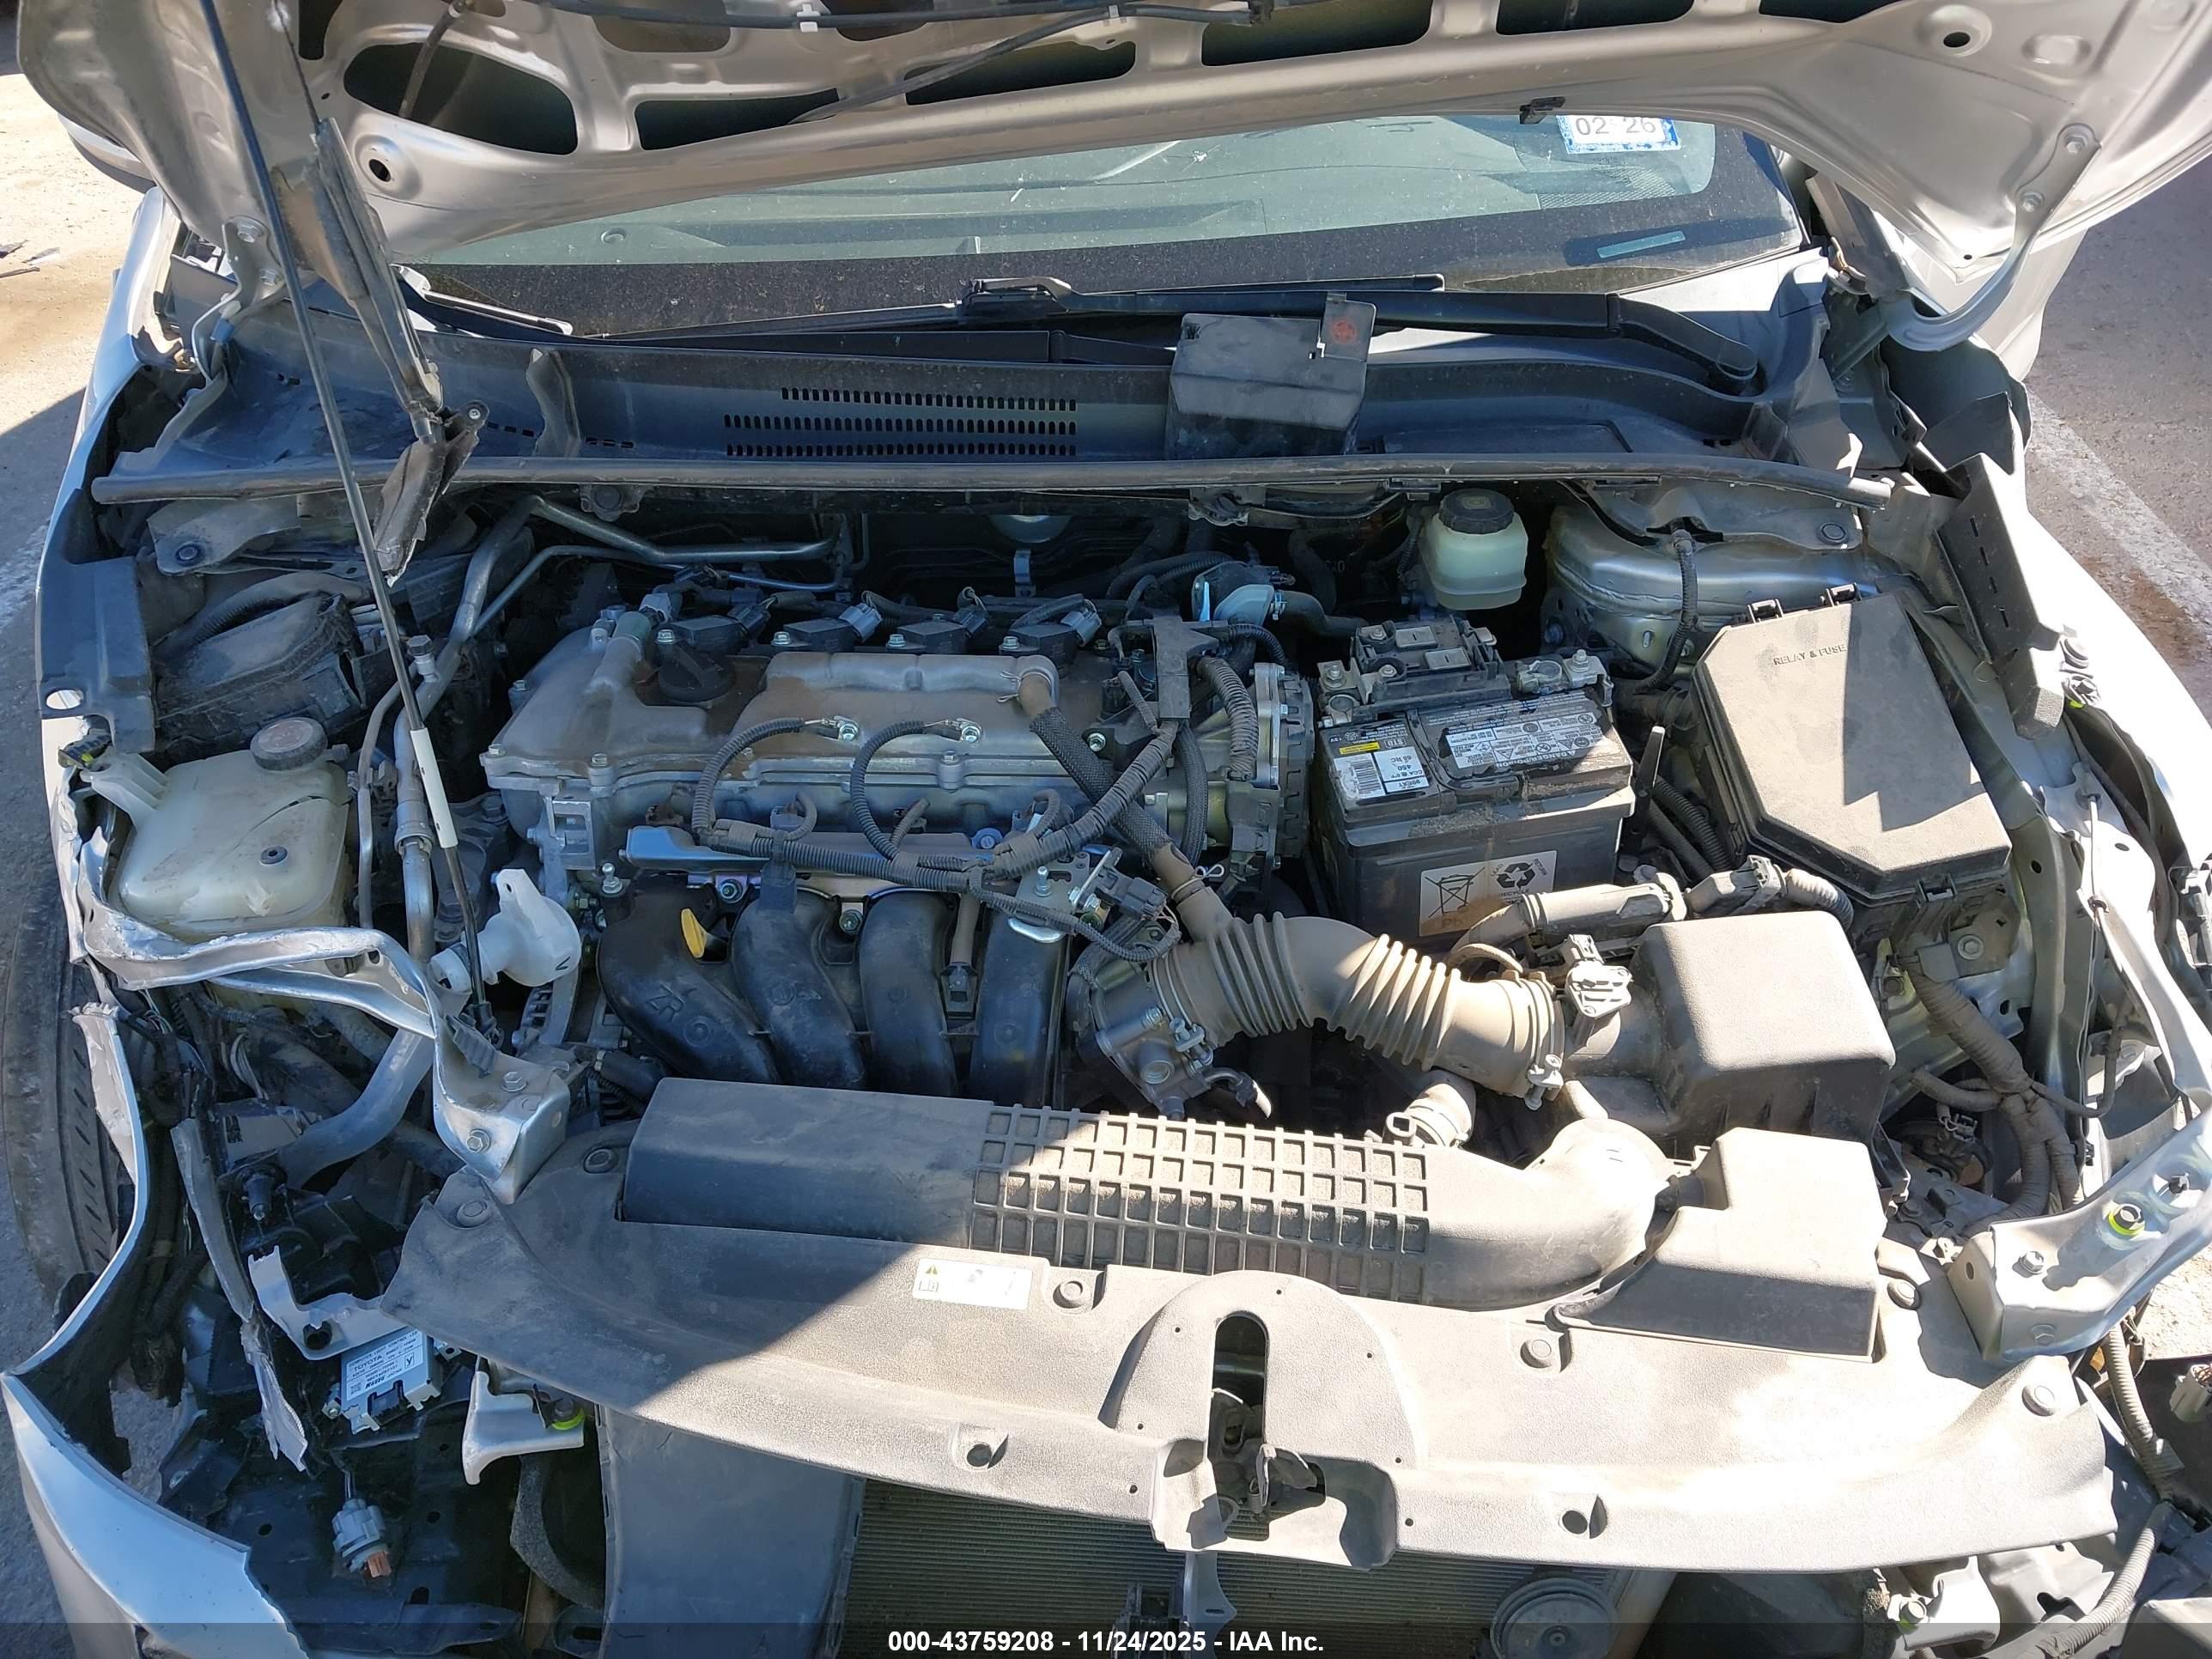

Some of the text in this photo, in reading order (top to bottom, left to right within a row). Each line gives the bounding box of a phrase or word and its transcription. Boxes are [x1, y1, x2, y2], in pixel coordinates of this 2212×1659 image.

[1575, 117, 1656, 136] 02 26
[1772, 644, 1847, 665] RELAY & FUSE
[354, 1355, 383, 1372] TOYOTA
